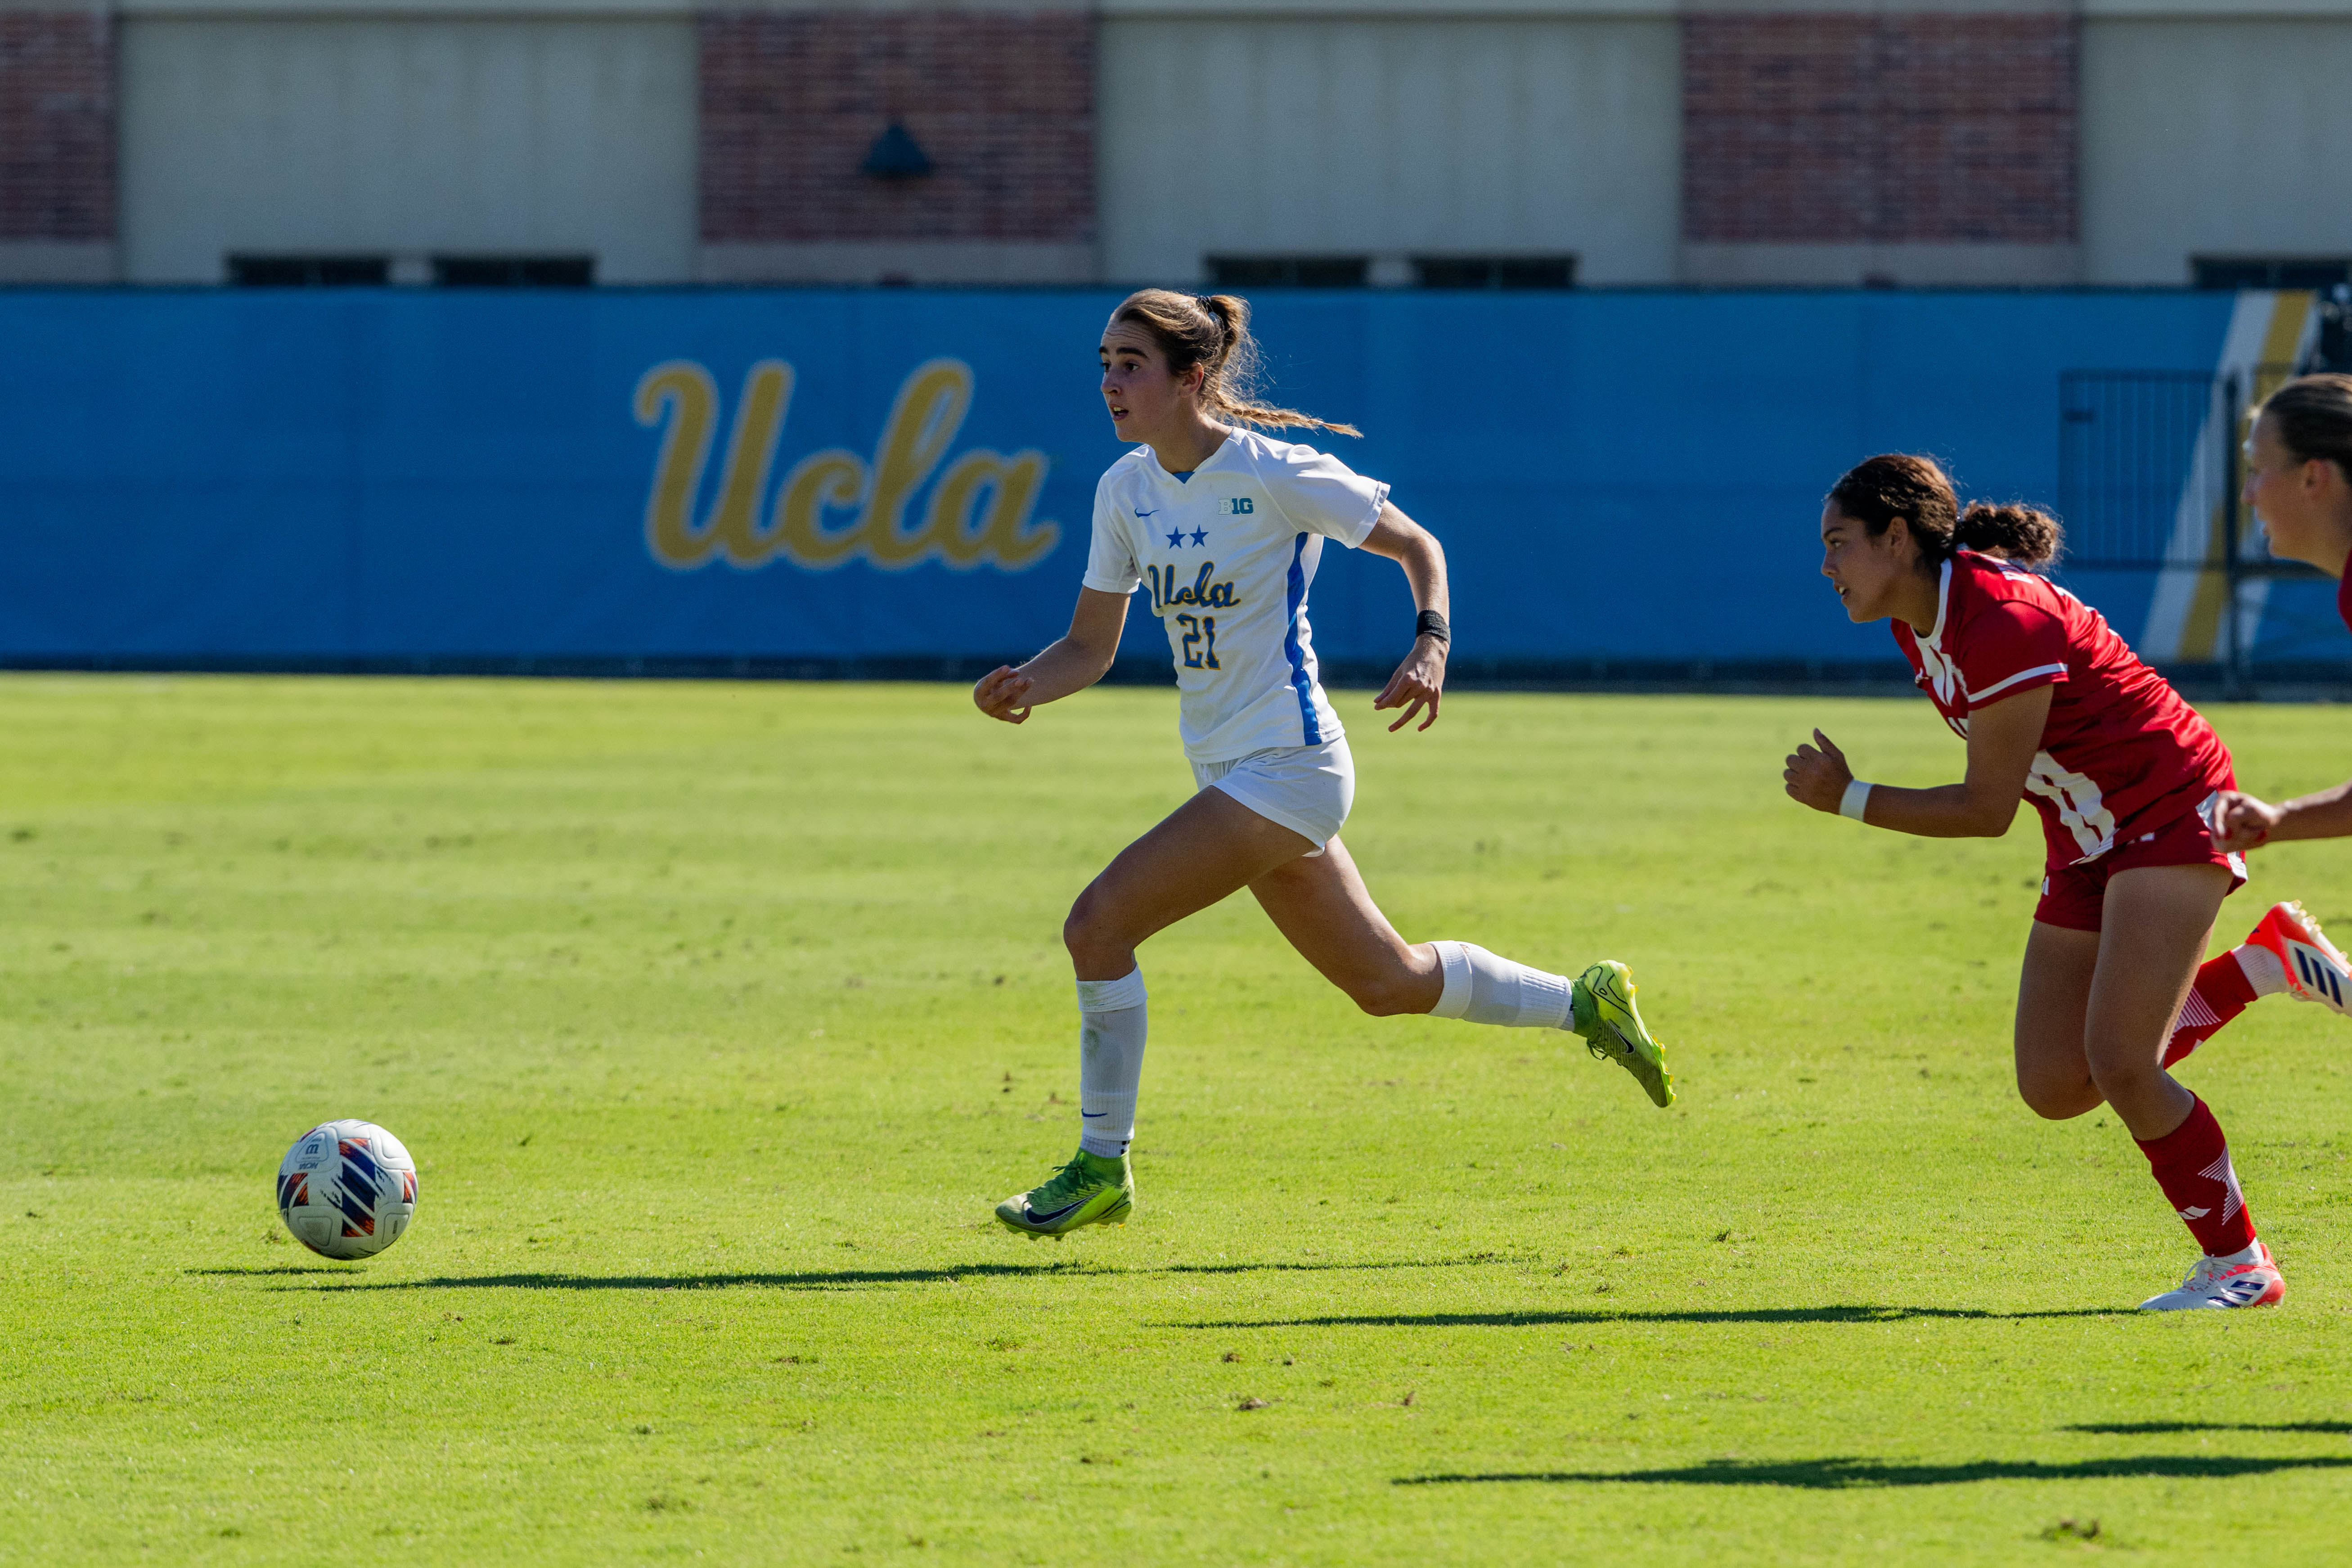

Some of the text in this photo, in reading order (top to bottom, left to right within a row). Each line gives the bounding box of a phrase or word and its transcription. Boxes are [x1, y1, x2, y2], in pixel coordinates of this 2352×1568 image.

[634, 360, 1060, 571] Ucla
[1147, 561, 1241, 608] Ucla
[1175, 612, 1221, 670] 21
